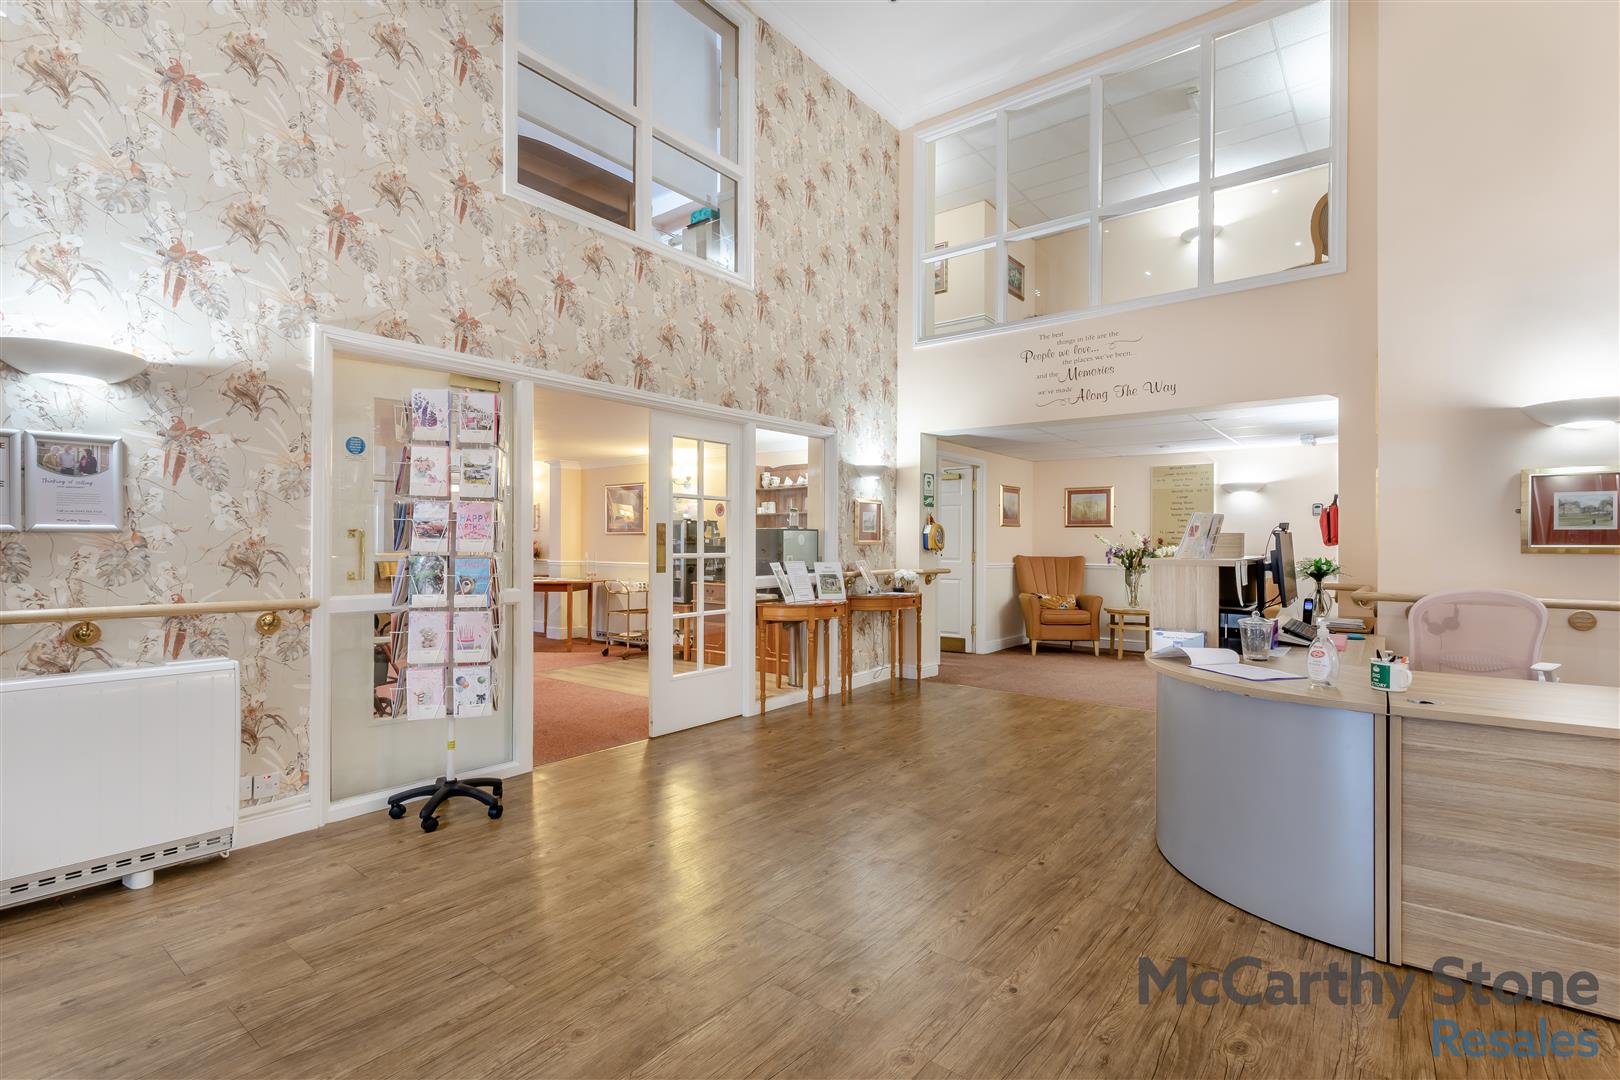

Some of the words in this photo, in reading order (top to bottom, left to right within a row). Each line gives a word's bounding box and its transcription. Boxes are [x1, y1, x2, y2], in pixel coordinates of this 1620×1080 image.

[1039, 333, 1051, 341] The
[1051, 331, 1064, 339] best
[1056, 337, 1076, 346] things
[1108, 330, 1120, 338] the
[1020, 346, 1055, 364] People
[1058, 348, 1070, 358] we
[1062, 358, 1073, 366] the
[1073, 355, 1094, 366] places
[1036, 372, 1048, 380] and
[1048, 371, 1059, 379] the
[1058, 364, 1115, 383] Memories
[1055, 386, 1072, 394] made
[1069, 388, 1108, 405] Along
[1113, 384, 1138, 398] The
[1142, 380, 1177, 396] Way
[459, 514, 489, 522] HAPPY
